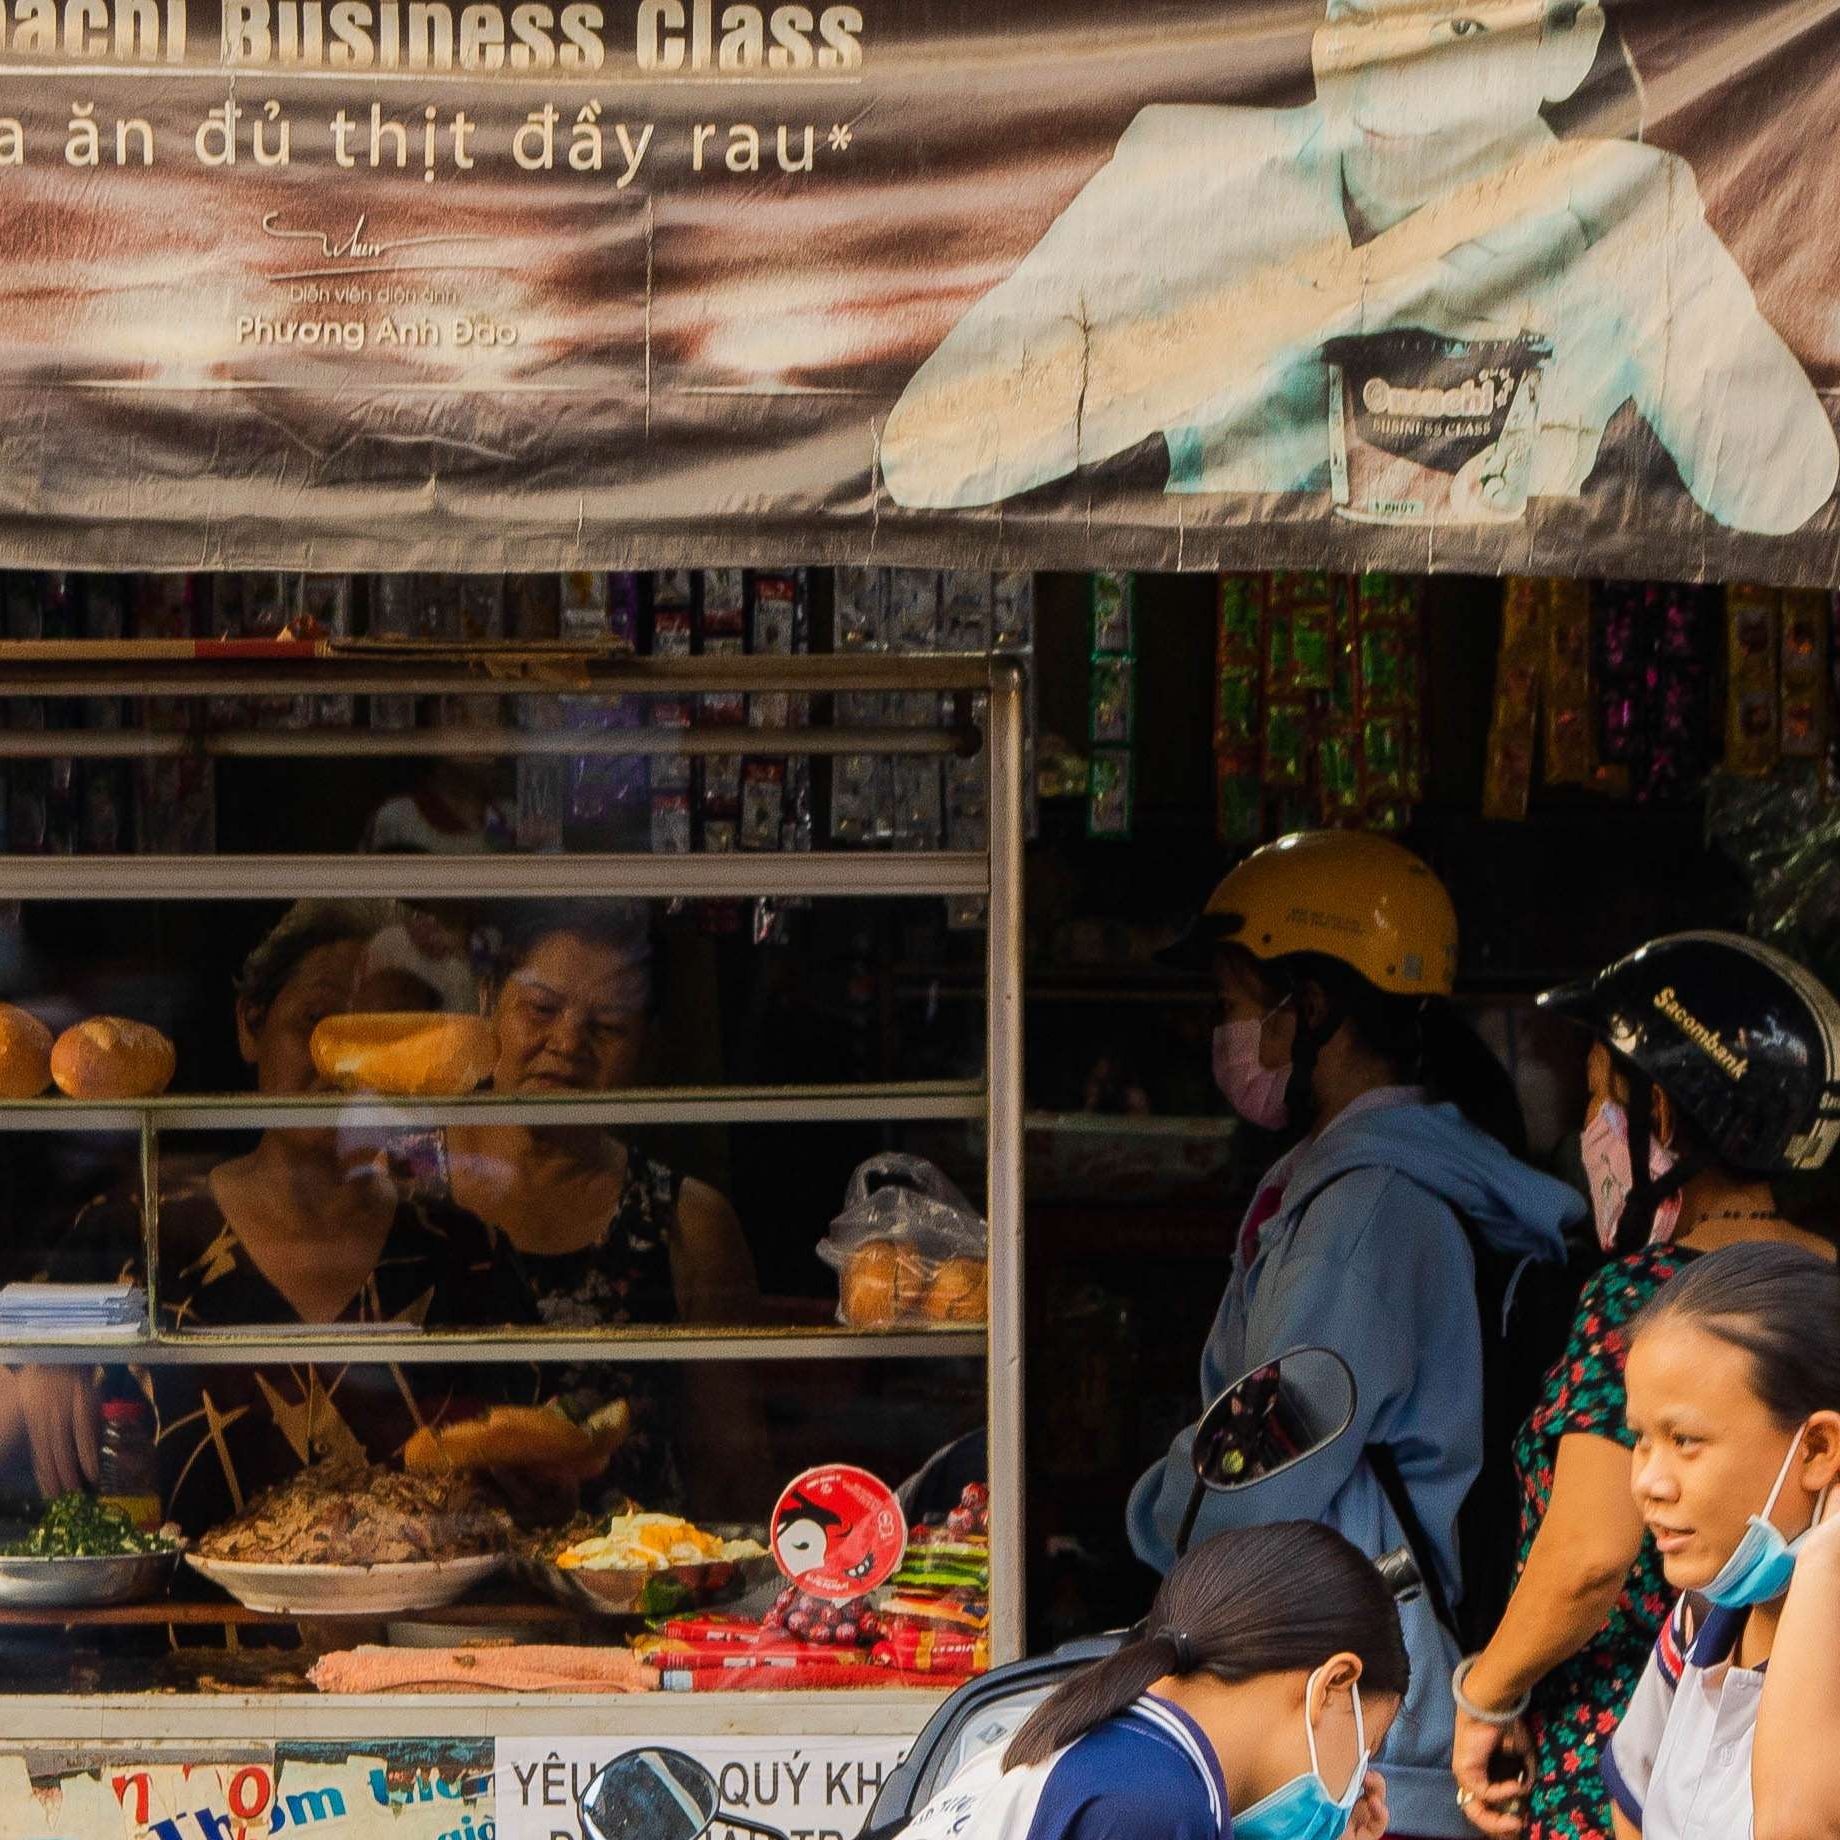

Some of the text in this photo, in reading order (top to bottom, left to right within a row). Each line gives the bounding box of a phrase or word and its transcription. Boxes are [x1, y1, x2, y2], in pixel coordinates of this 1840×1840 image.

[224, 0, 604, 71] Business
[636, 0, 862, 71] Class
[65, 104, 155, 167] ăn
[195, 100, 290, 168] đủ
[331, 103, 475, 185] thịt
[512, 100, 655, 189] đầy
[1654, 986, 1749, 1082] Sacombank
[719, 1750, 811, 1808] QUÝ
